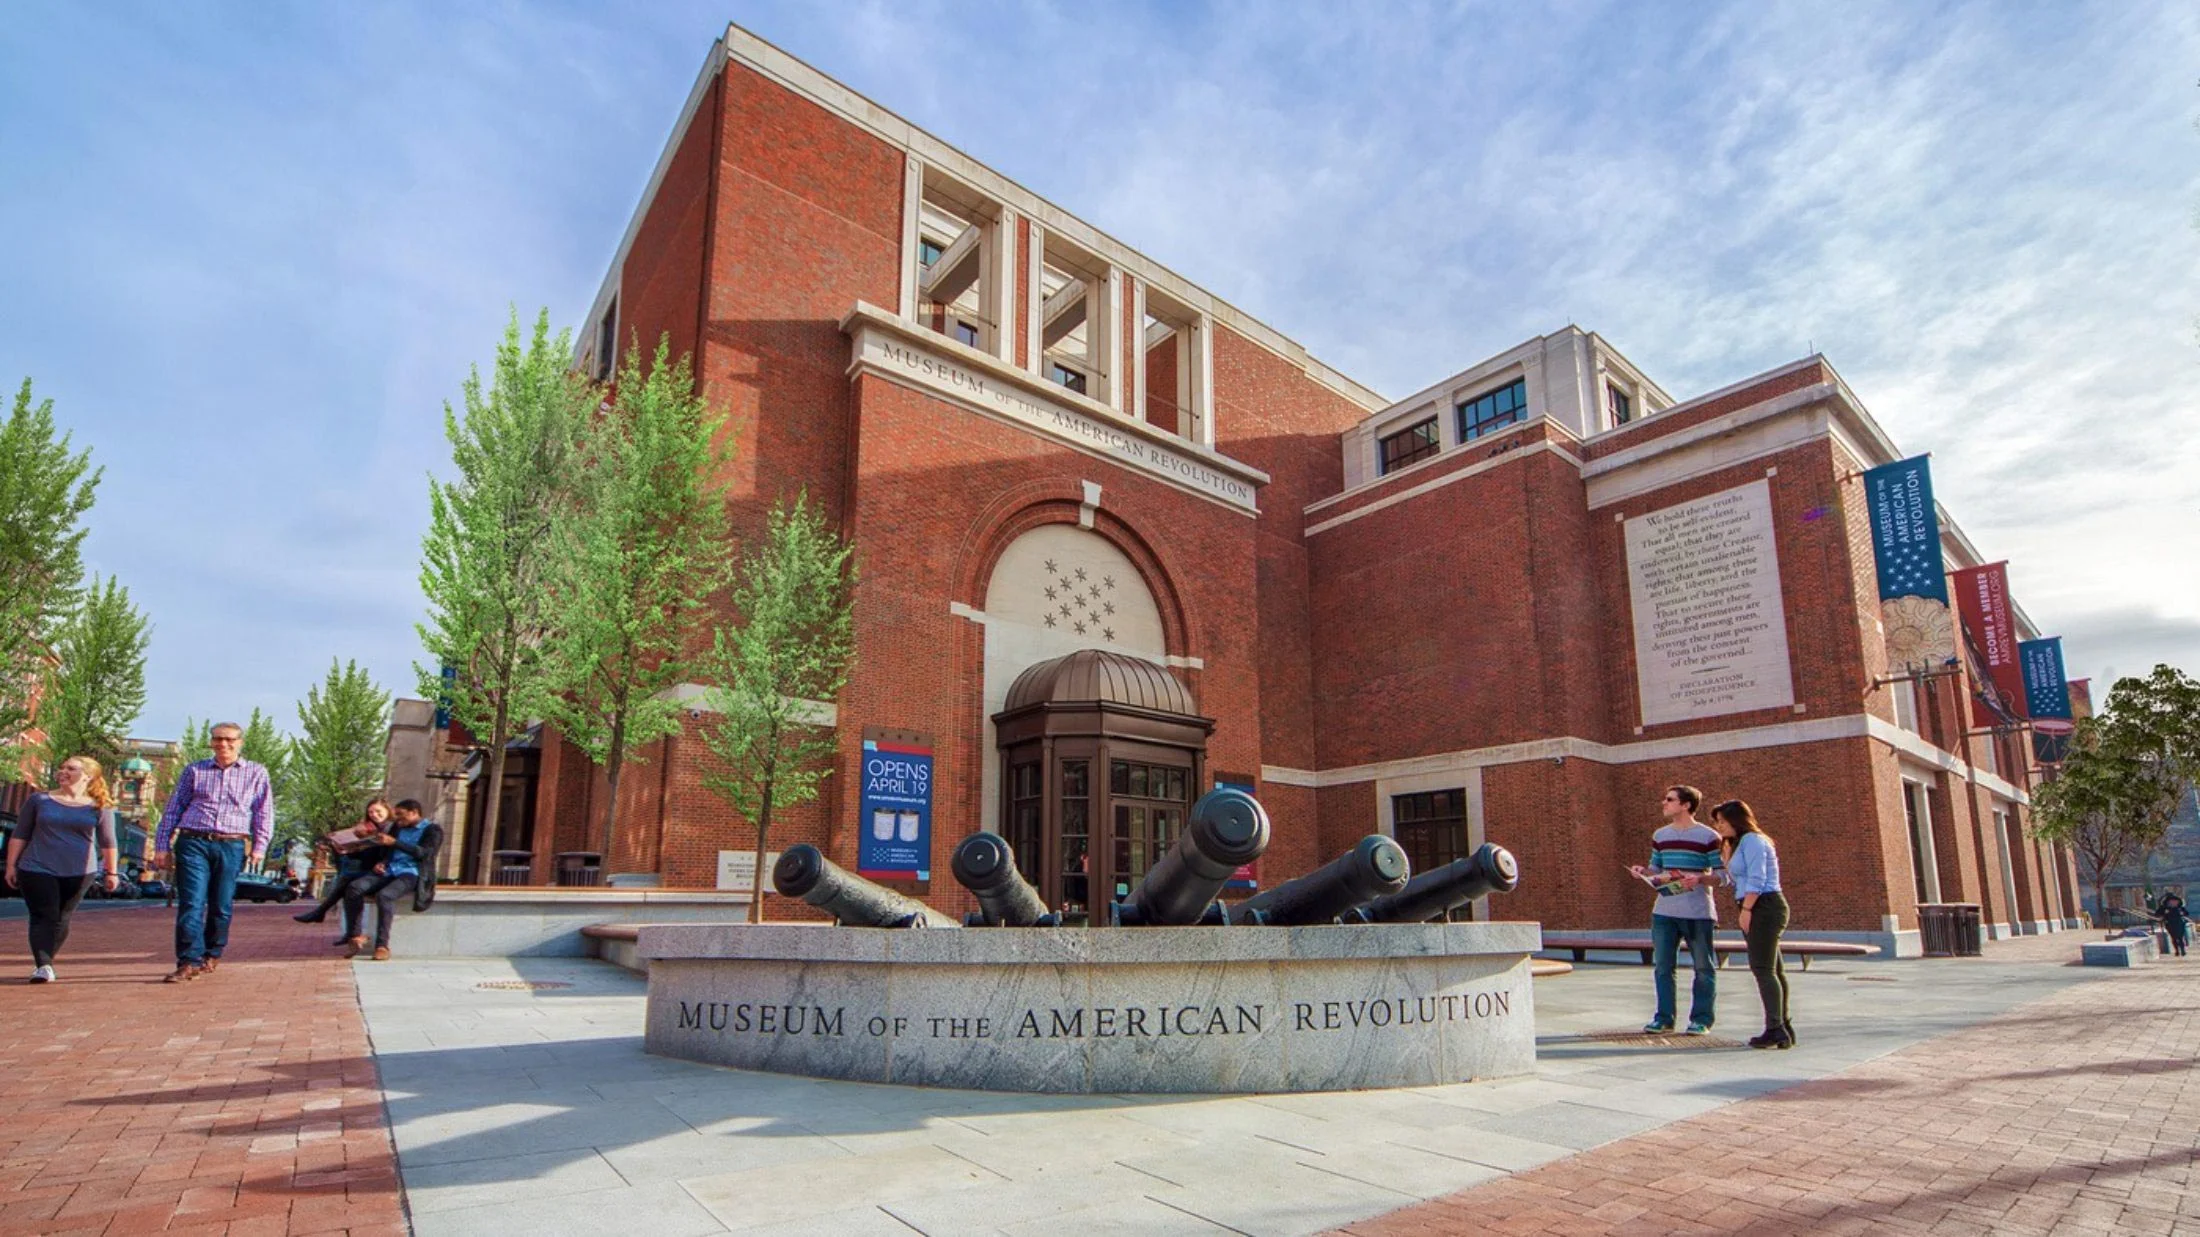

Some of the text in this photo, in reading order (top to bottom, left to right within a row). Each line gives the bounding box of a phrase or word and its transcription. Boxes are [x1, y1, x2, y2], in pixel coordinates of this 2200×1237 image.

[883, 343, 1249, 499] MUSEUM OF THE AMERICAN REVOLUTION
[1663, 509, 1685, 522] hold
[1878, 501, 1894, 547] MUSEUM
[1891, 483, 1910, 543] AMERICAN
[1905, 469, 1927, 541] REVOLUTION
[1642, 536, 1662, 549] That
[1716, 512, 1751, 528] created
[1977, 572, 2000, 666] BECOME A MEMBER
[867, 777, 928, 795] APRIL 19
[868, 759, 928, 781] OPENS
[678, 990, 1512, 1039] MUSEUM OF THE AMERICAN REVOLUTION
